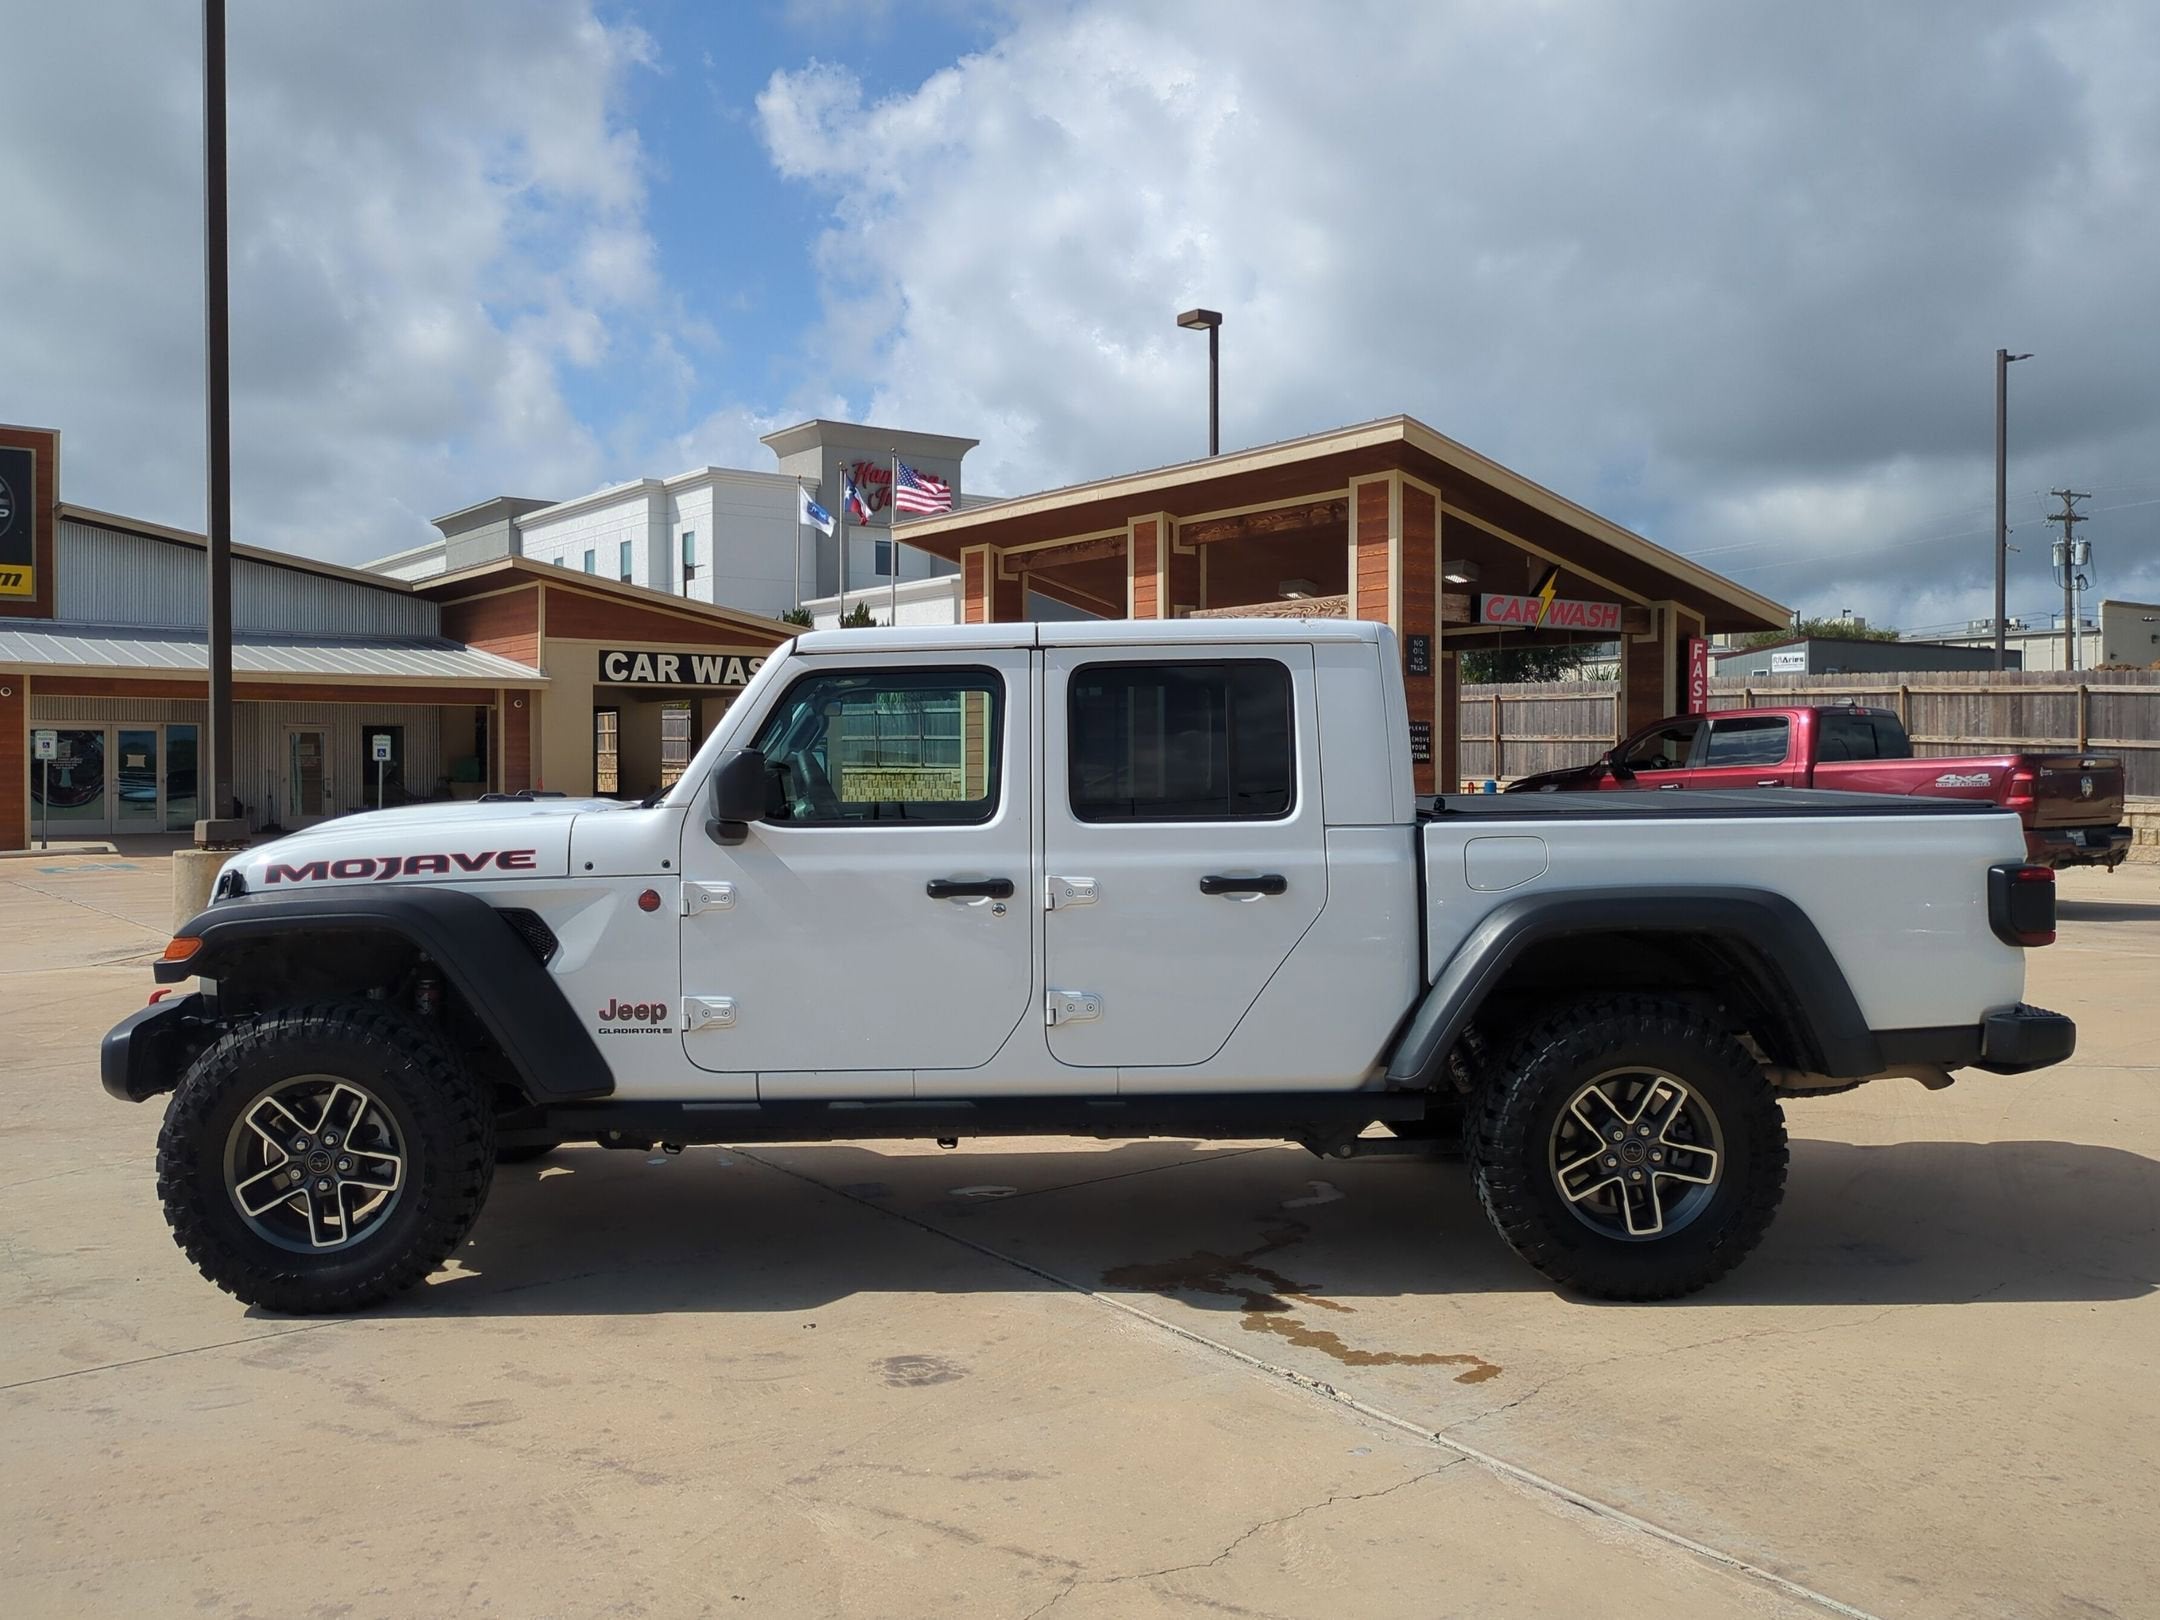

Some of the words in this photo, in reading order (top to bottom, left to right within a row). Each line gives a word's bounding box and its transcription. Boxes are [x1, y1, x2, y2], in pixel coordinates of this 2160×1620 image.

[1485, 596, 1541, 623] CAR
[1549, 601, 1619, 629] WASH
[604, 652, 681, 684] CAR
[691, 655, 765, 685] WAS
[1692, 643, 1704, 714] FAST
[264, 849, 537, 884] MOJAVE
[598, 997, 668, 1025] Jeep
[598, 1027, 662, 1035] GLADIATOR
